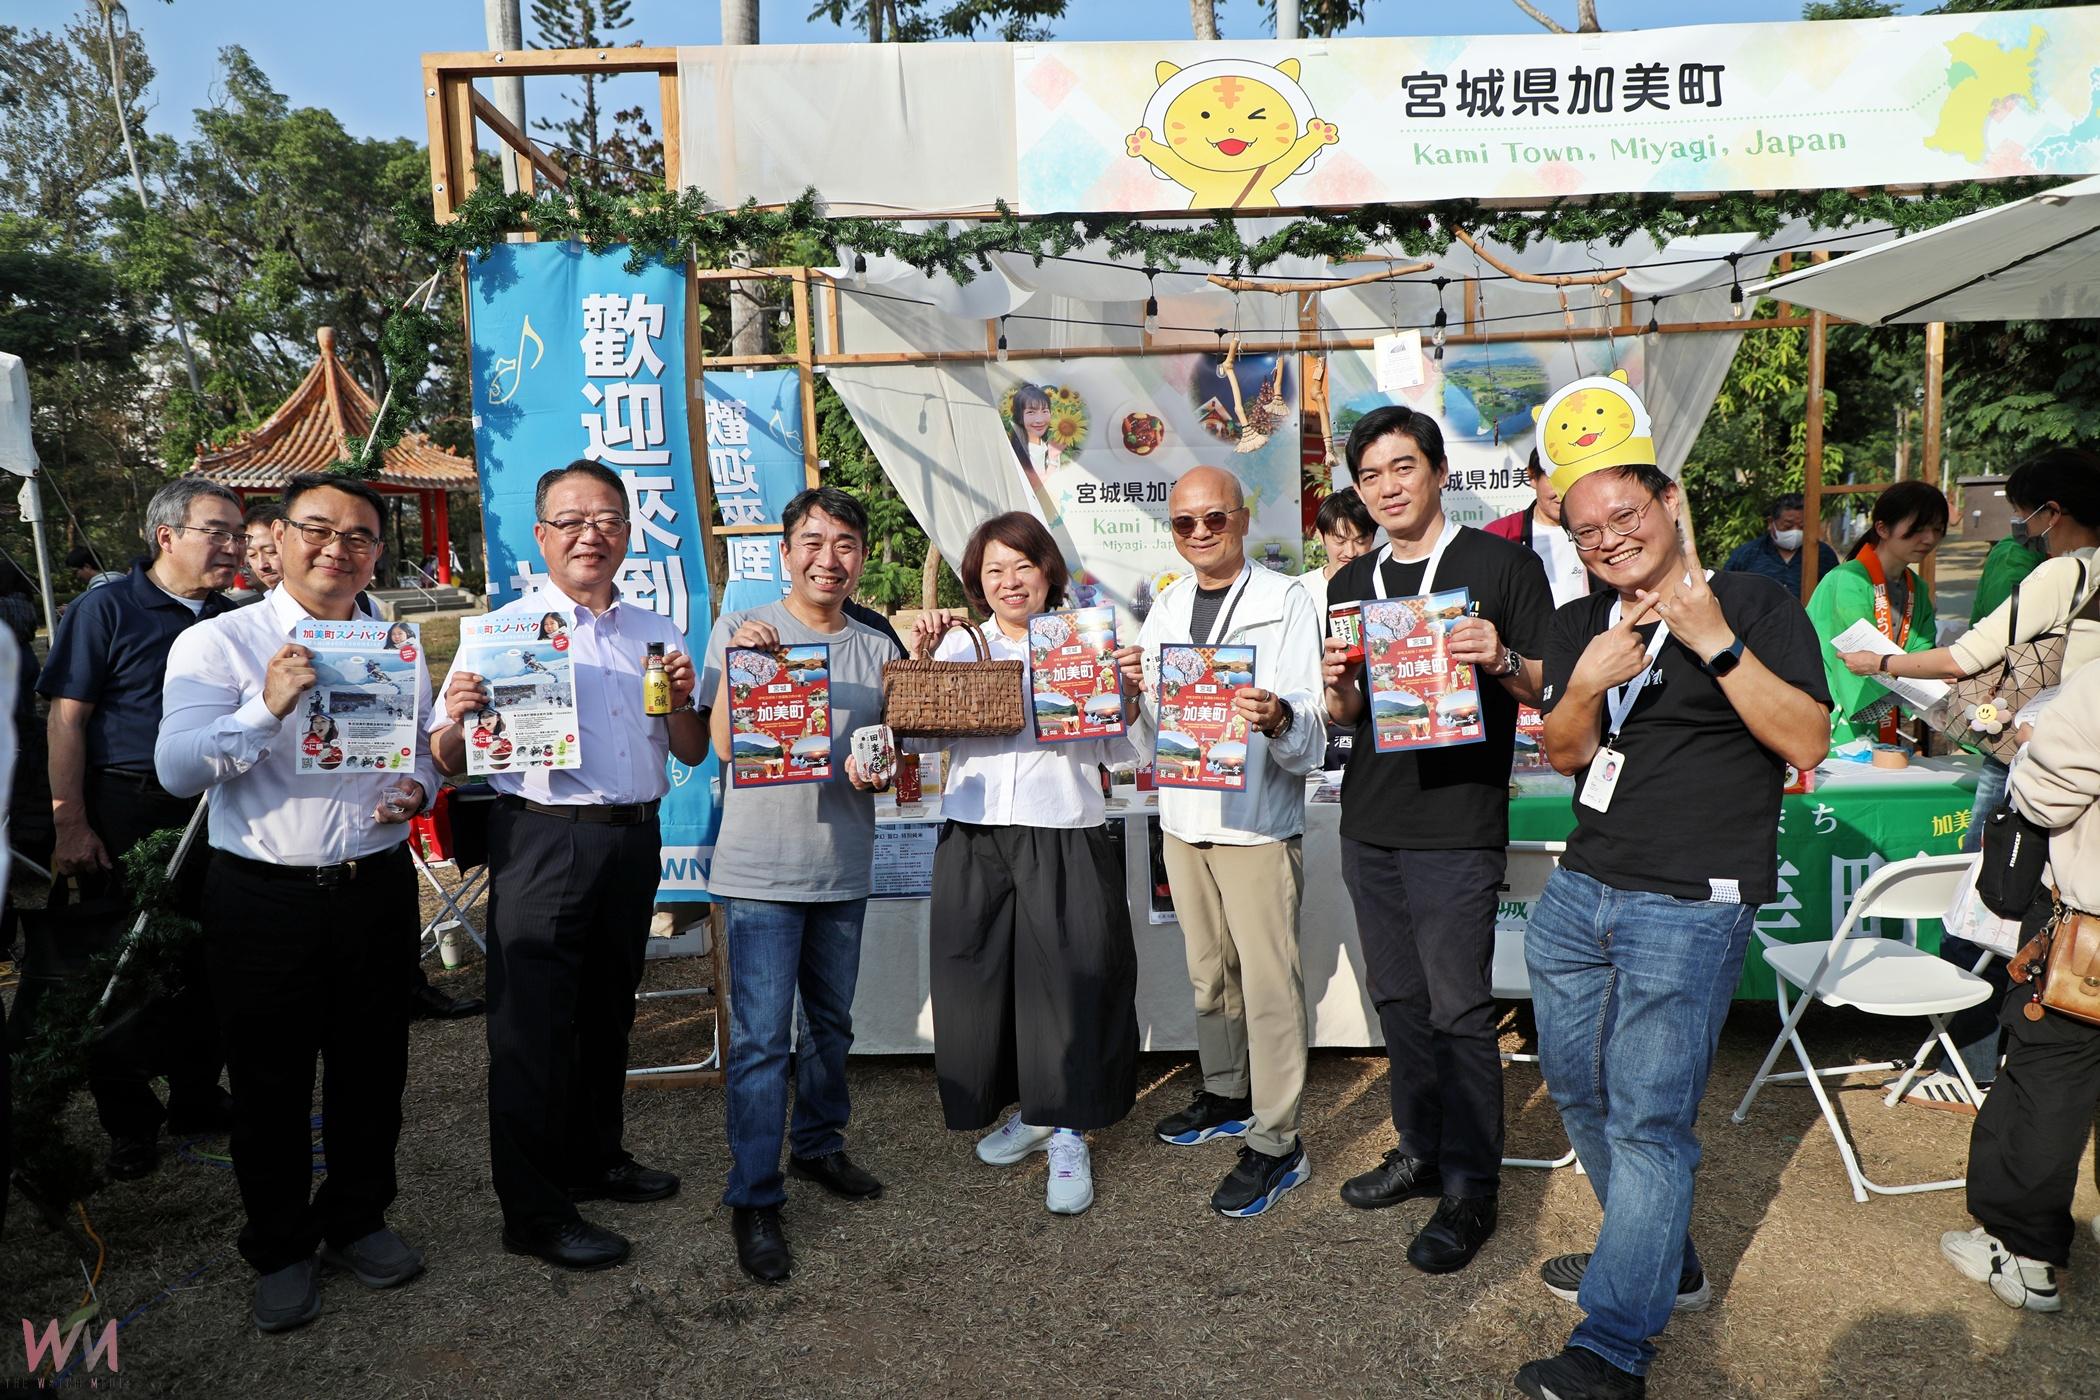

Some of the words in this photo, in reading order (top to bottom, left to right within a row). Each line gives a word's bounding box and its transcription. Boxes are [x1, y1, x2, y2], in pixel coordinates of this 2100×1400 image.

[1401, 62, 1725, 118] 宮城県加美町
[1413, 141, 1489, 166] Kami
[1501, 141, 1597, 164] Town,
[1610, 134, 1729, 165] Miyagi,
[1745, 130, 1847, 157] Japan
[1076, 481, 1177, 503] 宮城県加
[1093, 518, 1140, 535] Kami
[1149, 517, 1172, 533] To
[1152, 539, 1174, 550] Jap
[1053, 664, 1094, 682] 加美町
[1396, 657, 1449, 678] 加美町
[757, 704, 805, 722] 加美町
[1182, 706, 1228, 722] 加美町
